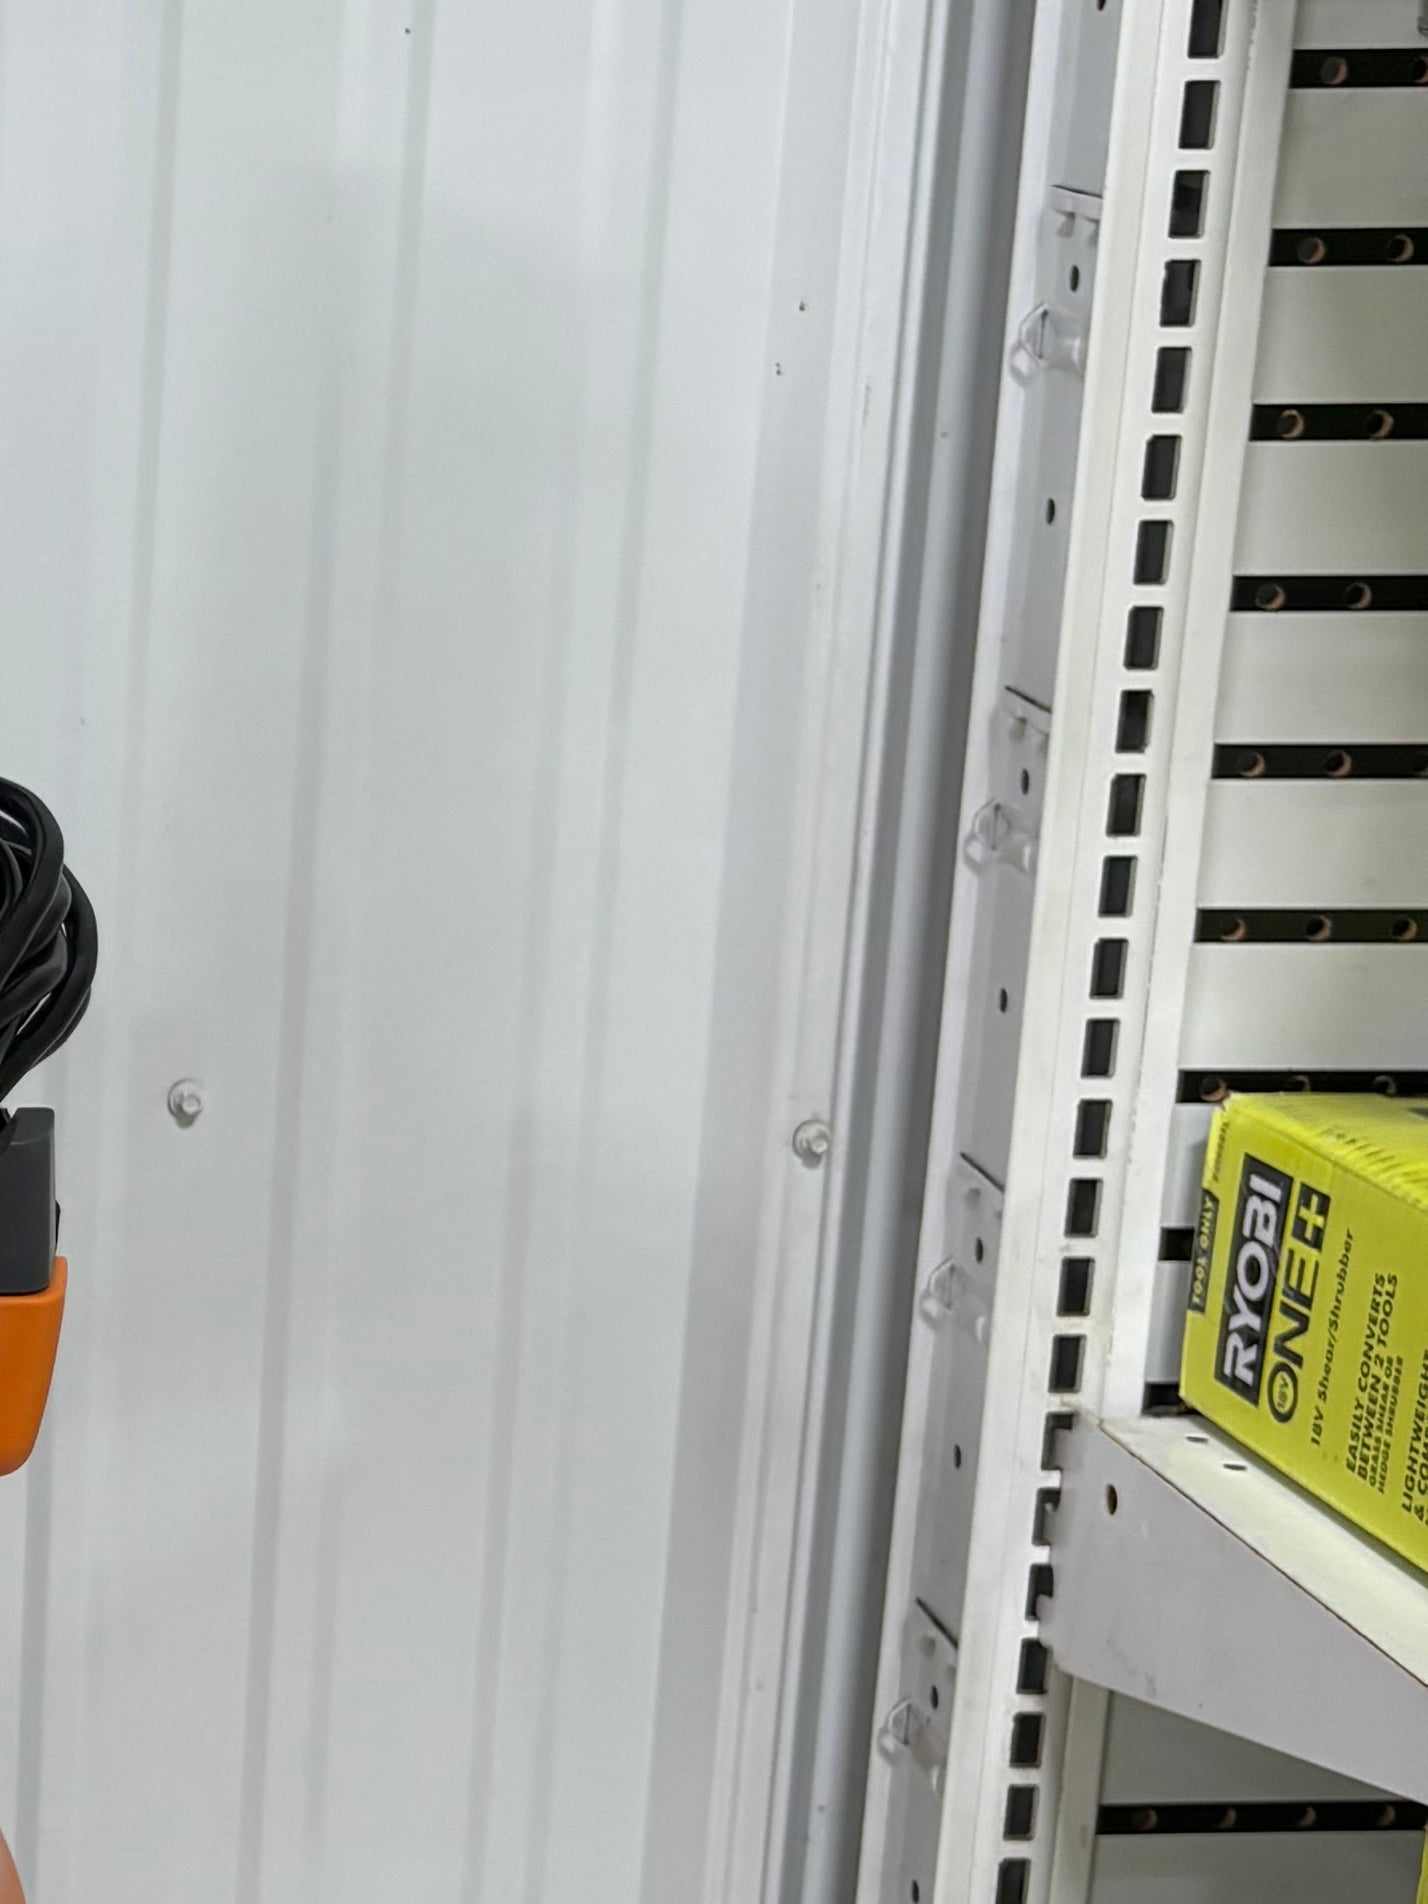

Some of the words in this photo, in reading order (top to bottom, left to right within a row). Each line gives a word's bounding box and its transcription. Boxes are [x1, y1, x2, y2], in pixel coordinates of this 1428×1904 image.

[1199, 1197, 1215, 1248] ONLY
[1192, 1252, 1207, 1304] TOOL
[1223, 1173, 1282, 1386] RYOBI
[1316, 1228, 1354, 1403] Shear/Shrubber
[1377, 1272, 1398, 1347] TOOLS
[1346, 1398, 1365, 1473] EASILY
[1358, 1272, 1386, 1392] CONVERTS
[1373, 1353, 1385, 1369] 2
[1310, 1405, 1323, 1446] 18V
[1357, 1373, 1382, 1481] BETWEEN
[1401, 1349, 1428, 1514] LIGHTWEIGH
